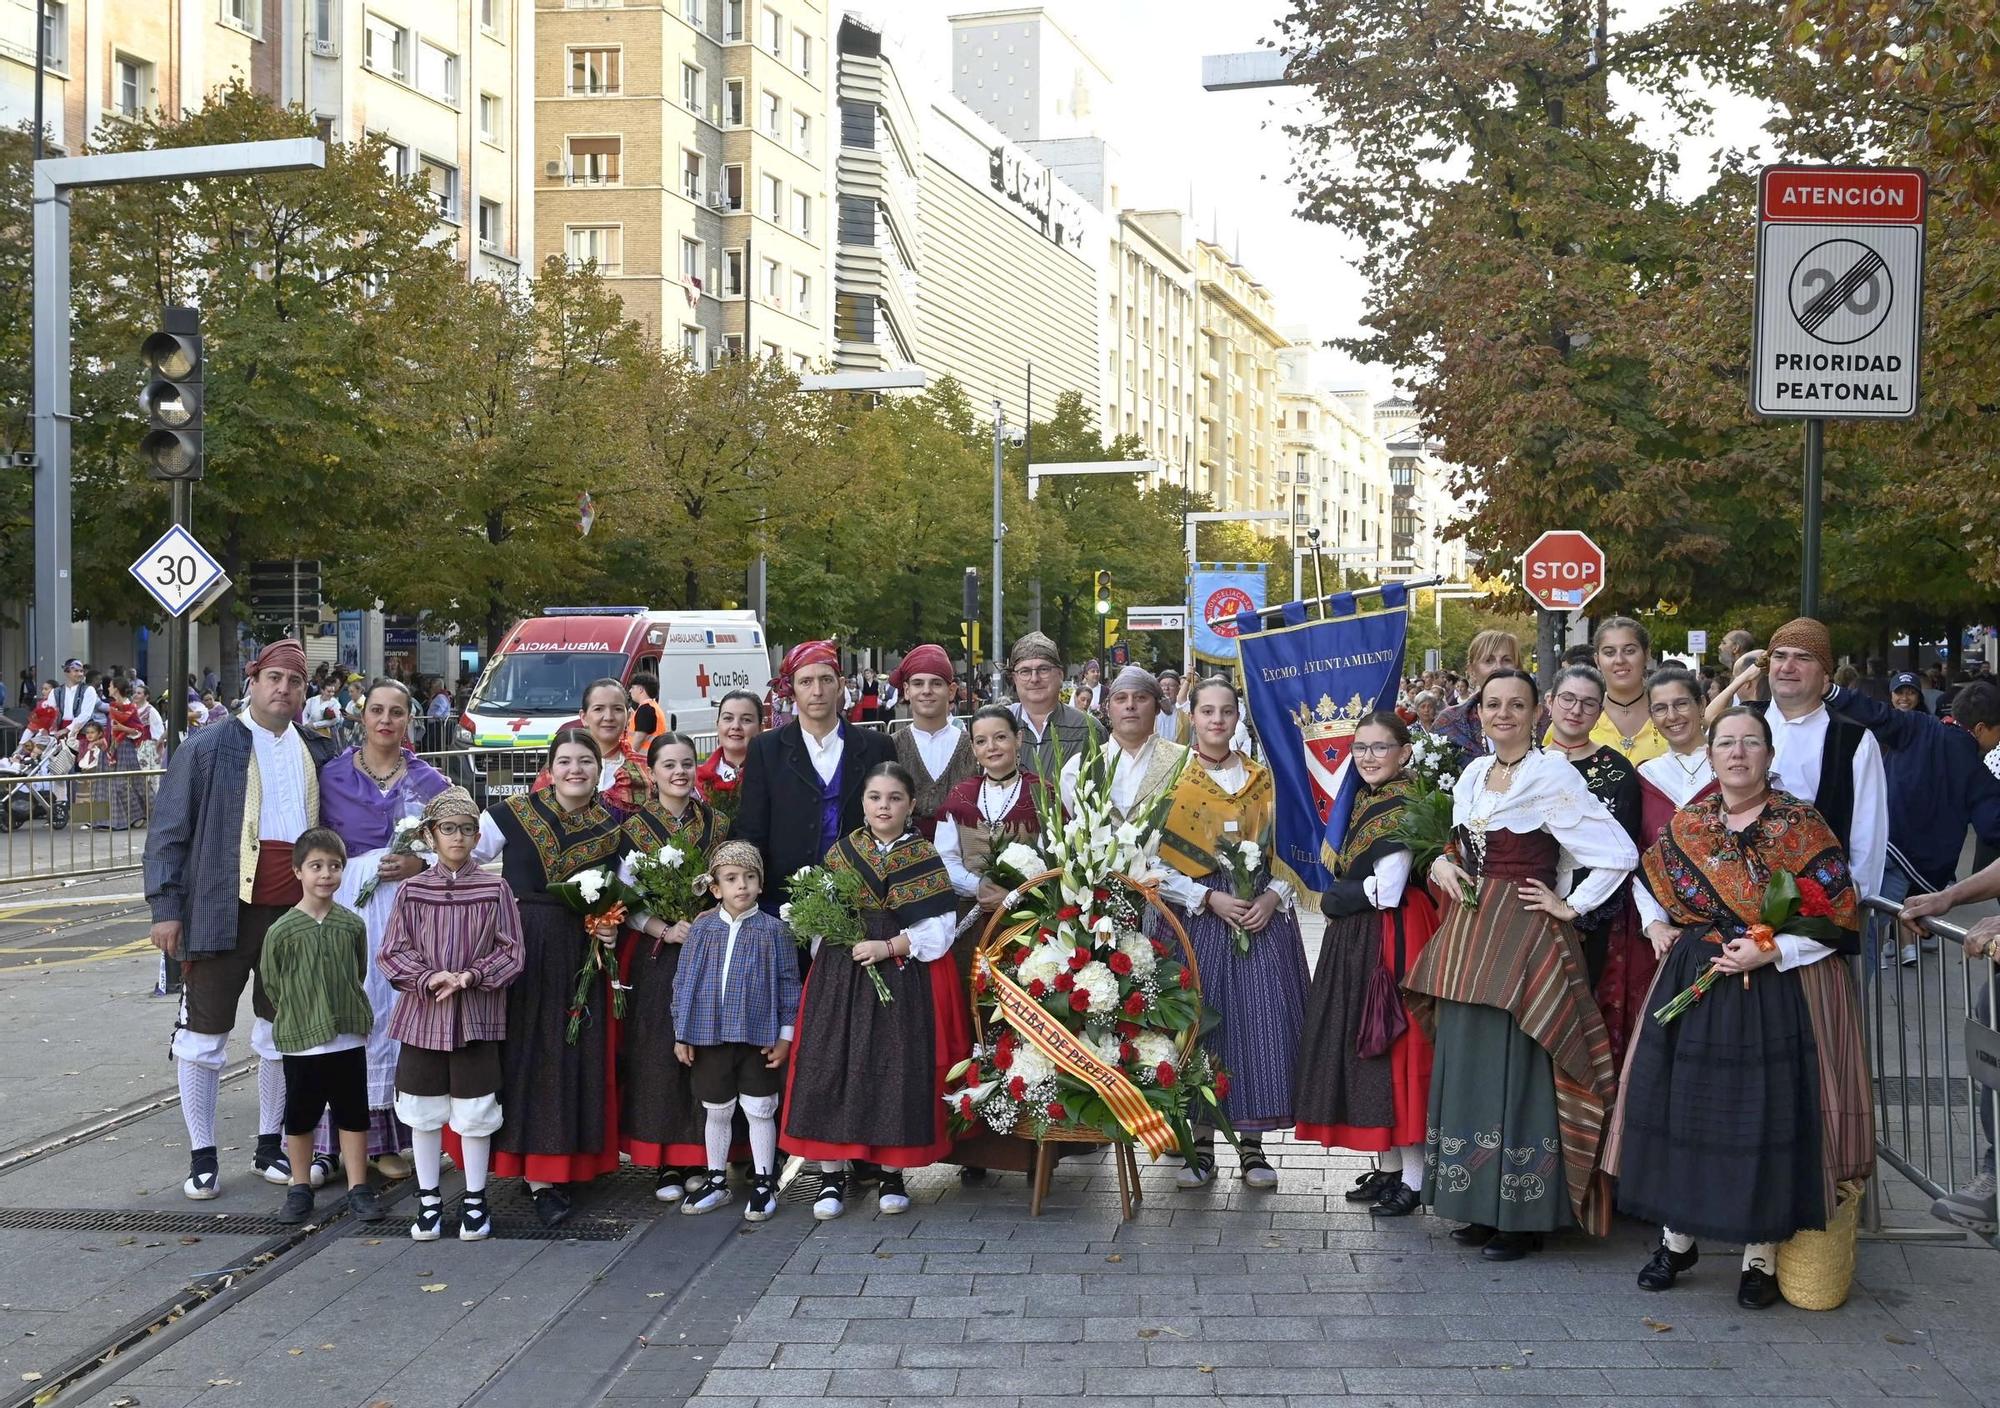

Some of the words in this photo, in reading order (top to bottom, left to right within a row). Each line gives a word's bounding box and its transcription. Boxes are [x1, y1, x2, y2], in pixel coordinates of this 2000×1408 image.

[1782, 185, 1904, 206] ATENCIÓN
[1801, 268, 1880, 315] 20
[1775, 354, 1901, 372] PRIORIDAD
[1776, 383, 1898, 400] PEATONAL
[156, 555, 197, 585] 30
[1532, 562, 1595, 579] STOP
[669, 633, 704, 643] AMBULANCIA
[1304, 649, 1393, 675] AYUNTAMIENTO
[713, 672, 731, 687] Cruz
[732, 670, 749, 688] Roja
[1046, 1031, 1069, 1051] DE
